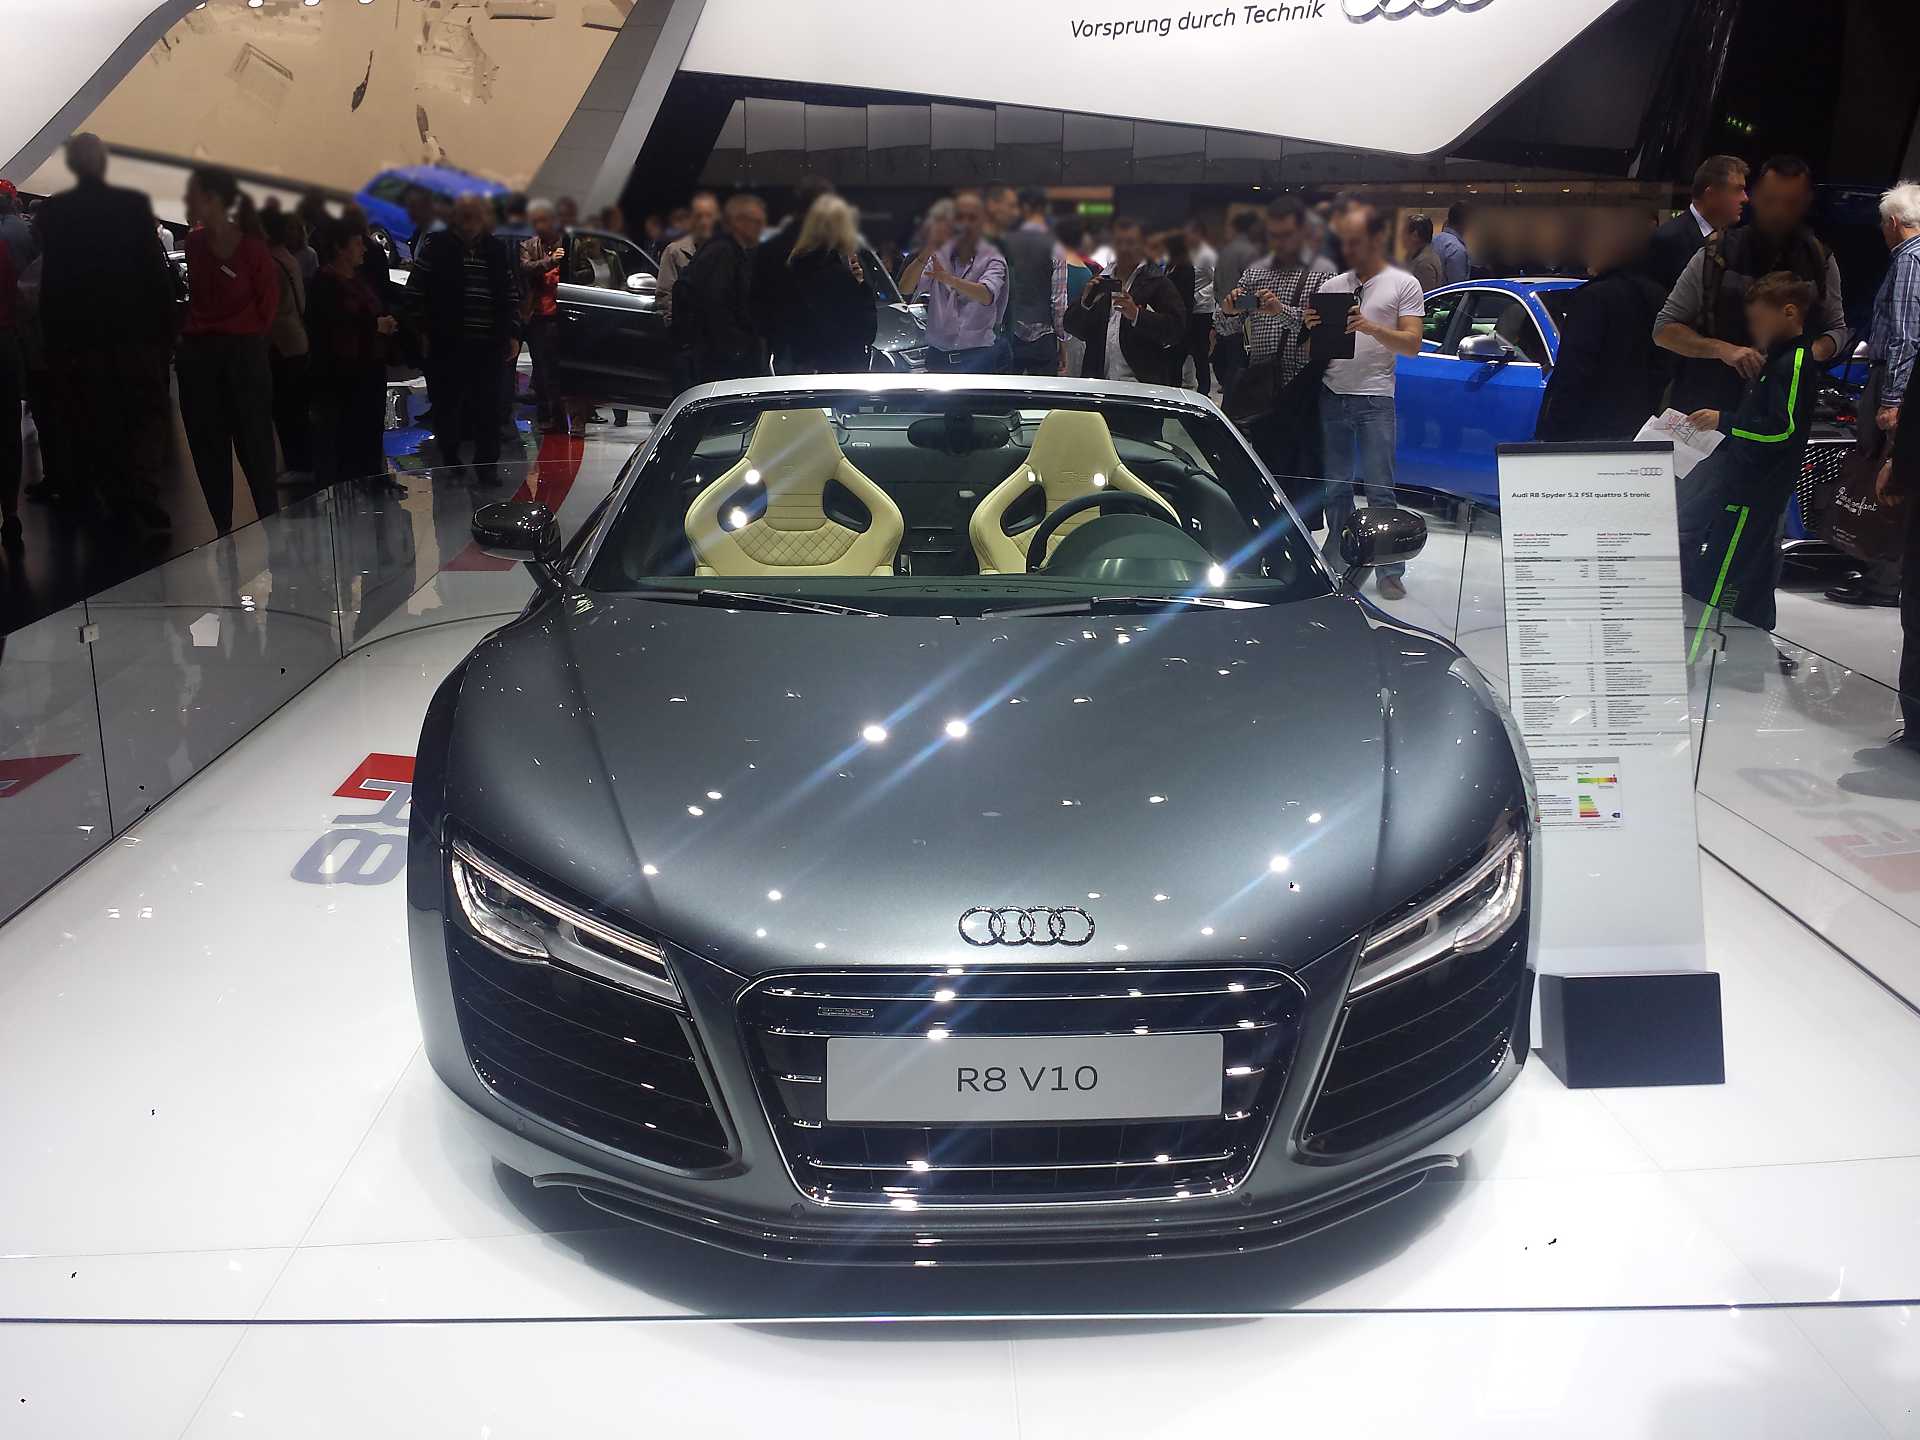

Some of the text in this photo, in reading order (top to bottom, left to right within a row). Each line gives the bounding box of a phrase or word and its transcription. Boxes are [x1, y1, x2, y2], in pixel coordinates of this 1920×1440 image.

[1071, 0, 1325, 41] Vorsprung durch Technik
[1541, 491, 1566, 500] Spyder
[1594, 491, 1622, 500] quattro
[956, 1065, 1099, 1093] R8 V10
